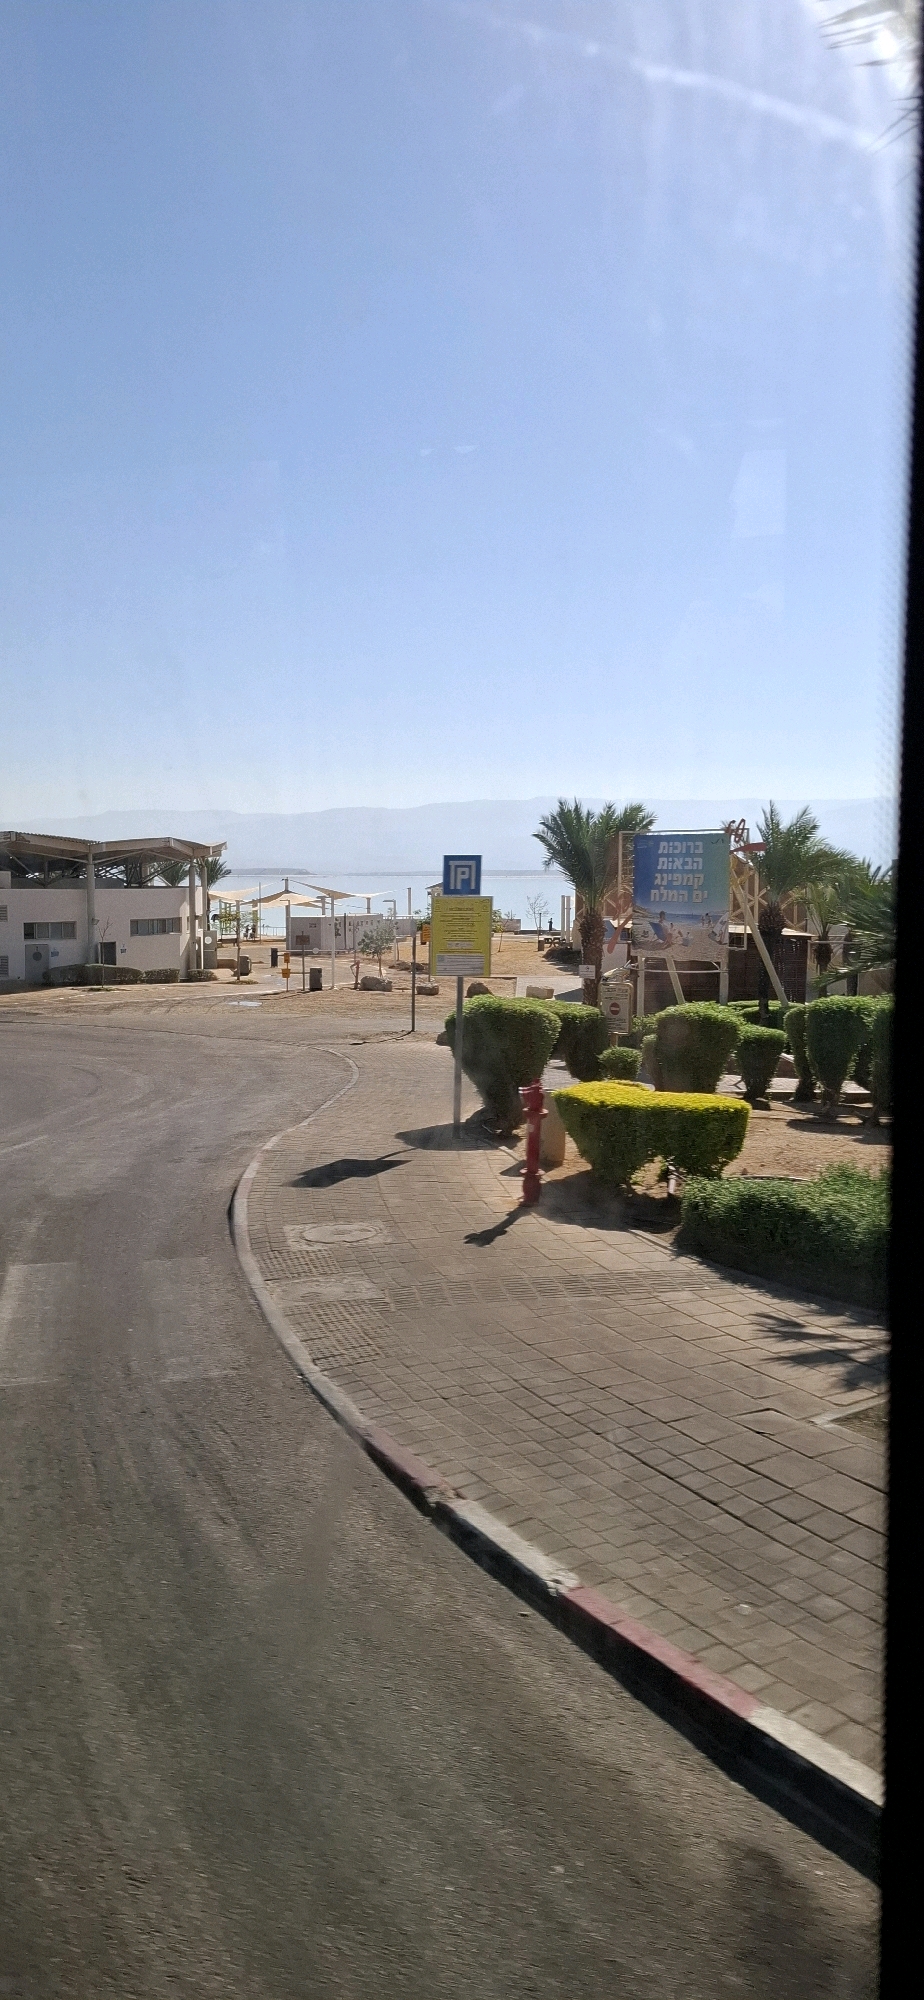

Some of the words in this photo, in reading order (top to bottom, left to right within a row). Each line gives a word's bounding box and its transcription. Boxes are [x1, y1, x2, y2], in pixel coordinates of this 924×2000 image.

[654, 873, 704, 890] קמפינג
[650, 886, 688, 902] המלח
[693, 890, 708, 903] ים
